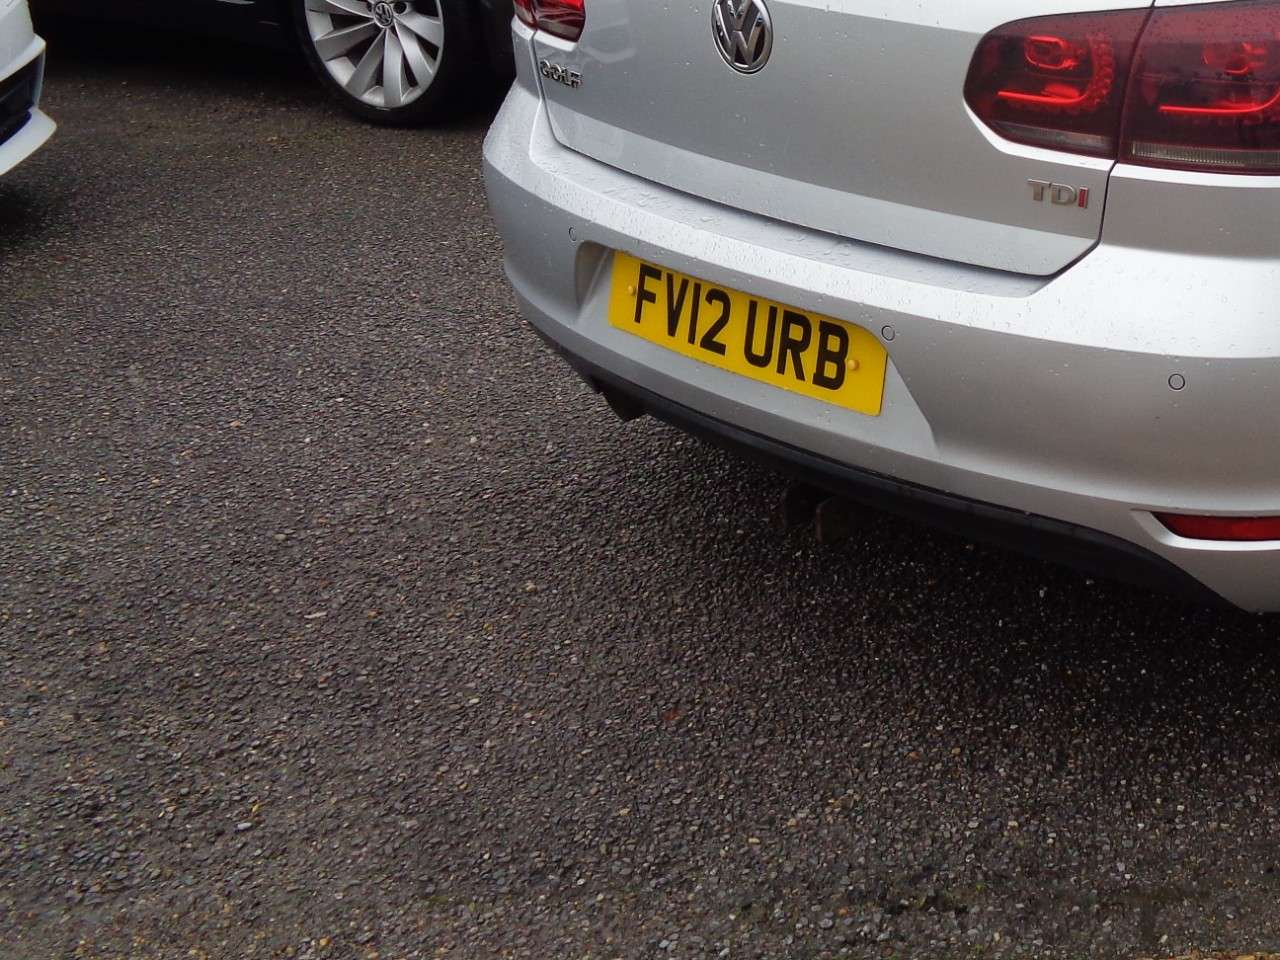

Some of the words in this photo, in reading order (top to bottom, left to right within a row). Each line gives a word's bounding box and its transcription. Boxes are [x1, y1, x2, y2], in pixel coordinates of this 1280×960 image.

[1026, 178, 1088, 209] TDI
[634, 263, 732, 356] FV12
[743, 300, 850, 391] URB
